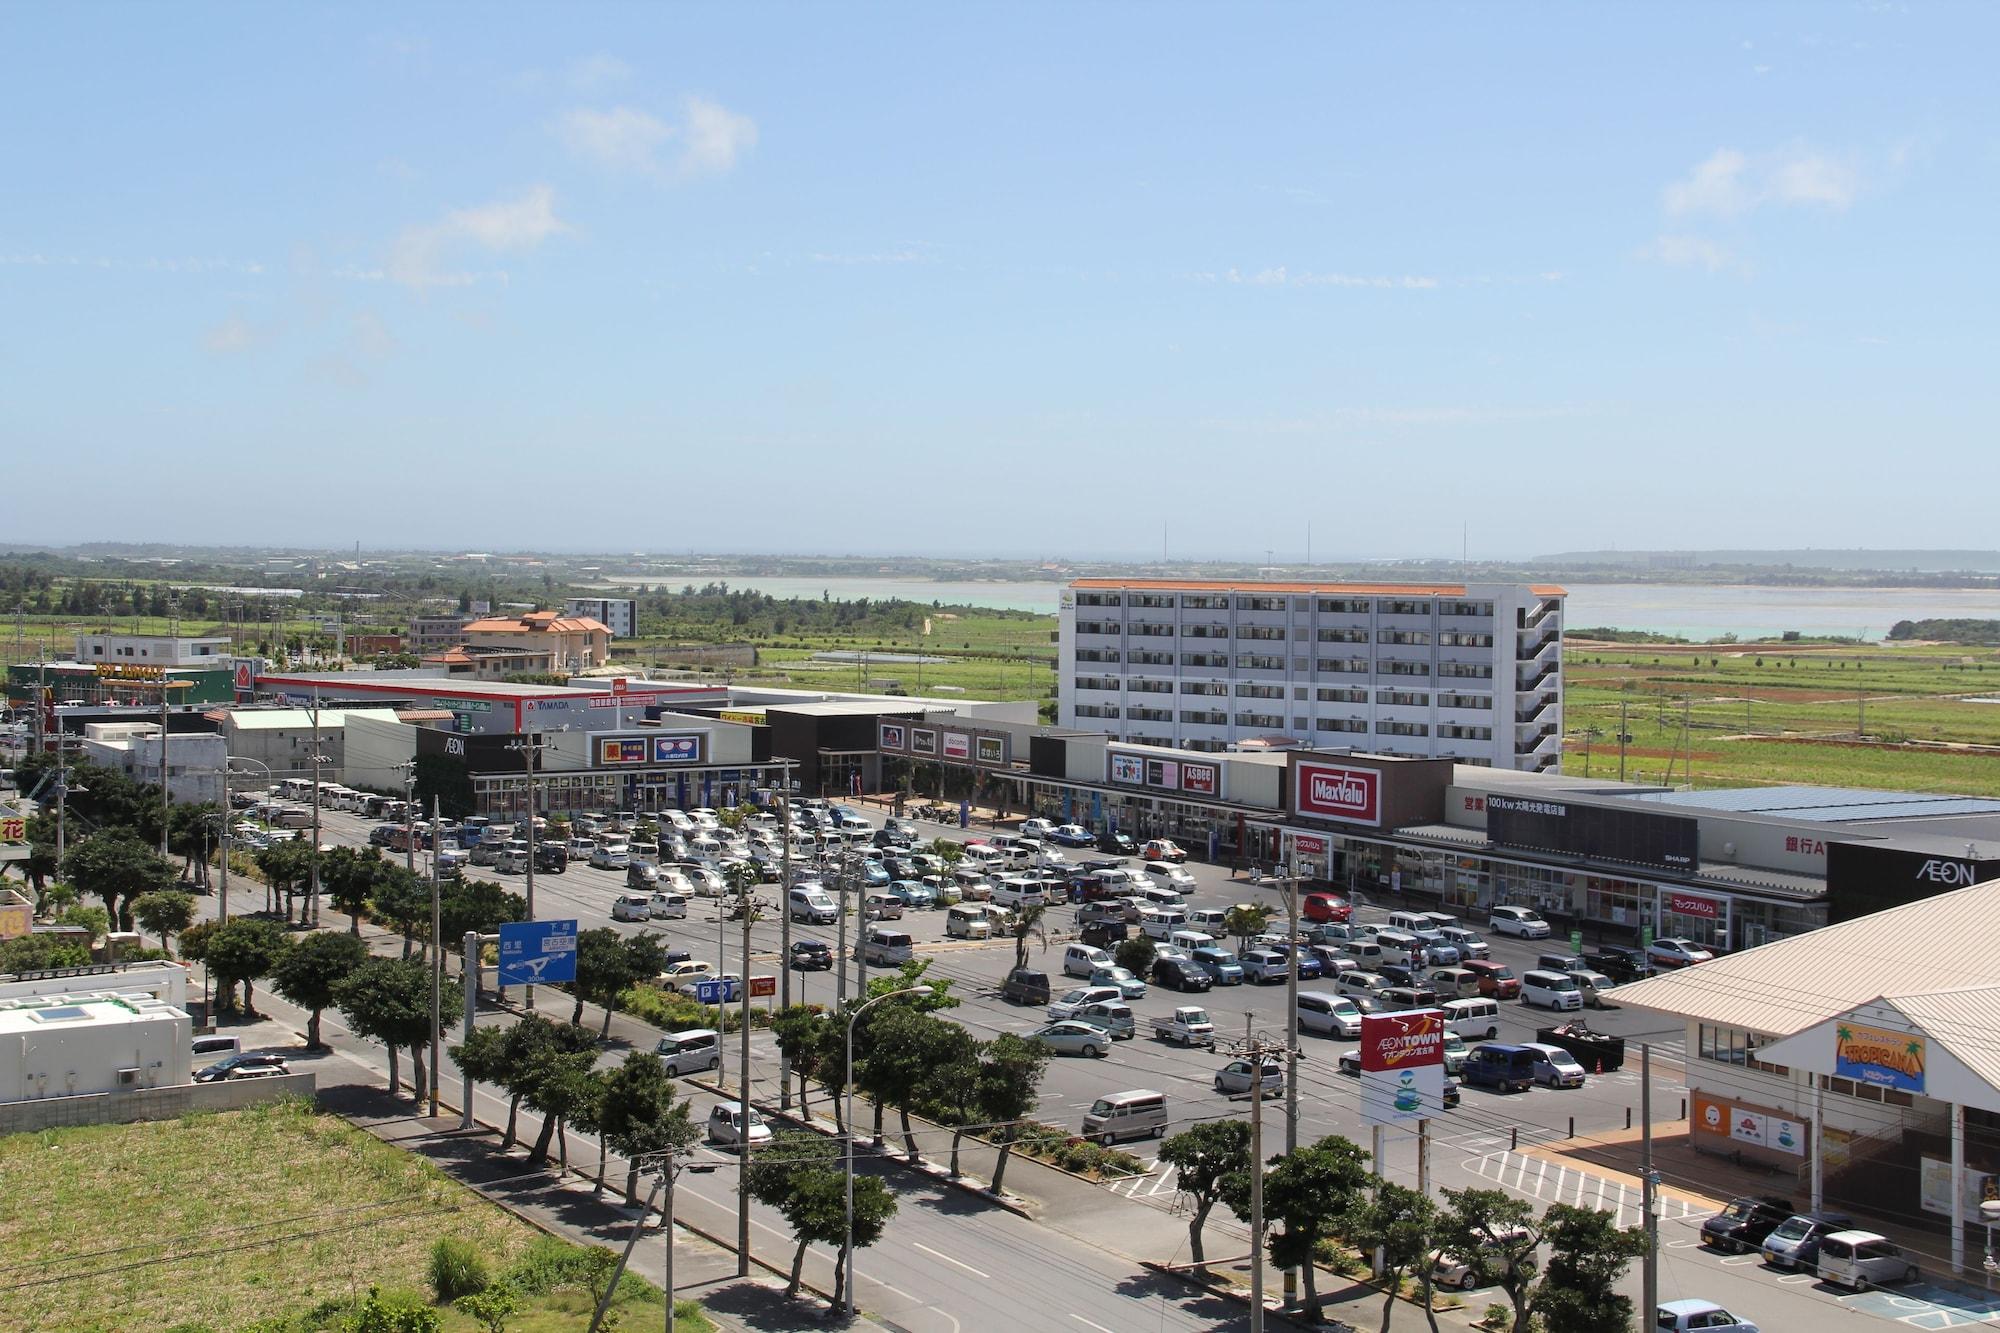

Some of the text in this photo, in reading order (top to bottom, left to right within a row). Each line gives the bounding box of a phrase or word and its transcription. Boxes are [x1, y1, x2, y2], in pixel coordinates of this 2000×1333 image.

[537, 701, 569, 711] YAMADA
[948, 737, 967, 747] docomo
[1314, 772, 1363, 804] MaxValu
[1464, 796, 1487, 812] 営業
[1488, 796, 1500, 808] 100
[1515, 801, 1566, 817] 太陽光発電店舗
[2, 819, 24, 839] 花
[1786, 836, 1827, 856] 銀行A
[1664, 854, 1691, 863] SHARP
[1674, 899, 1714, 913] マックスバリュ
[1845, 1044, 1916, 1079] TROPICANA
